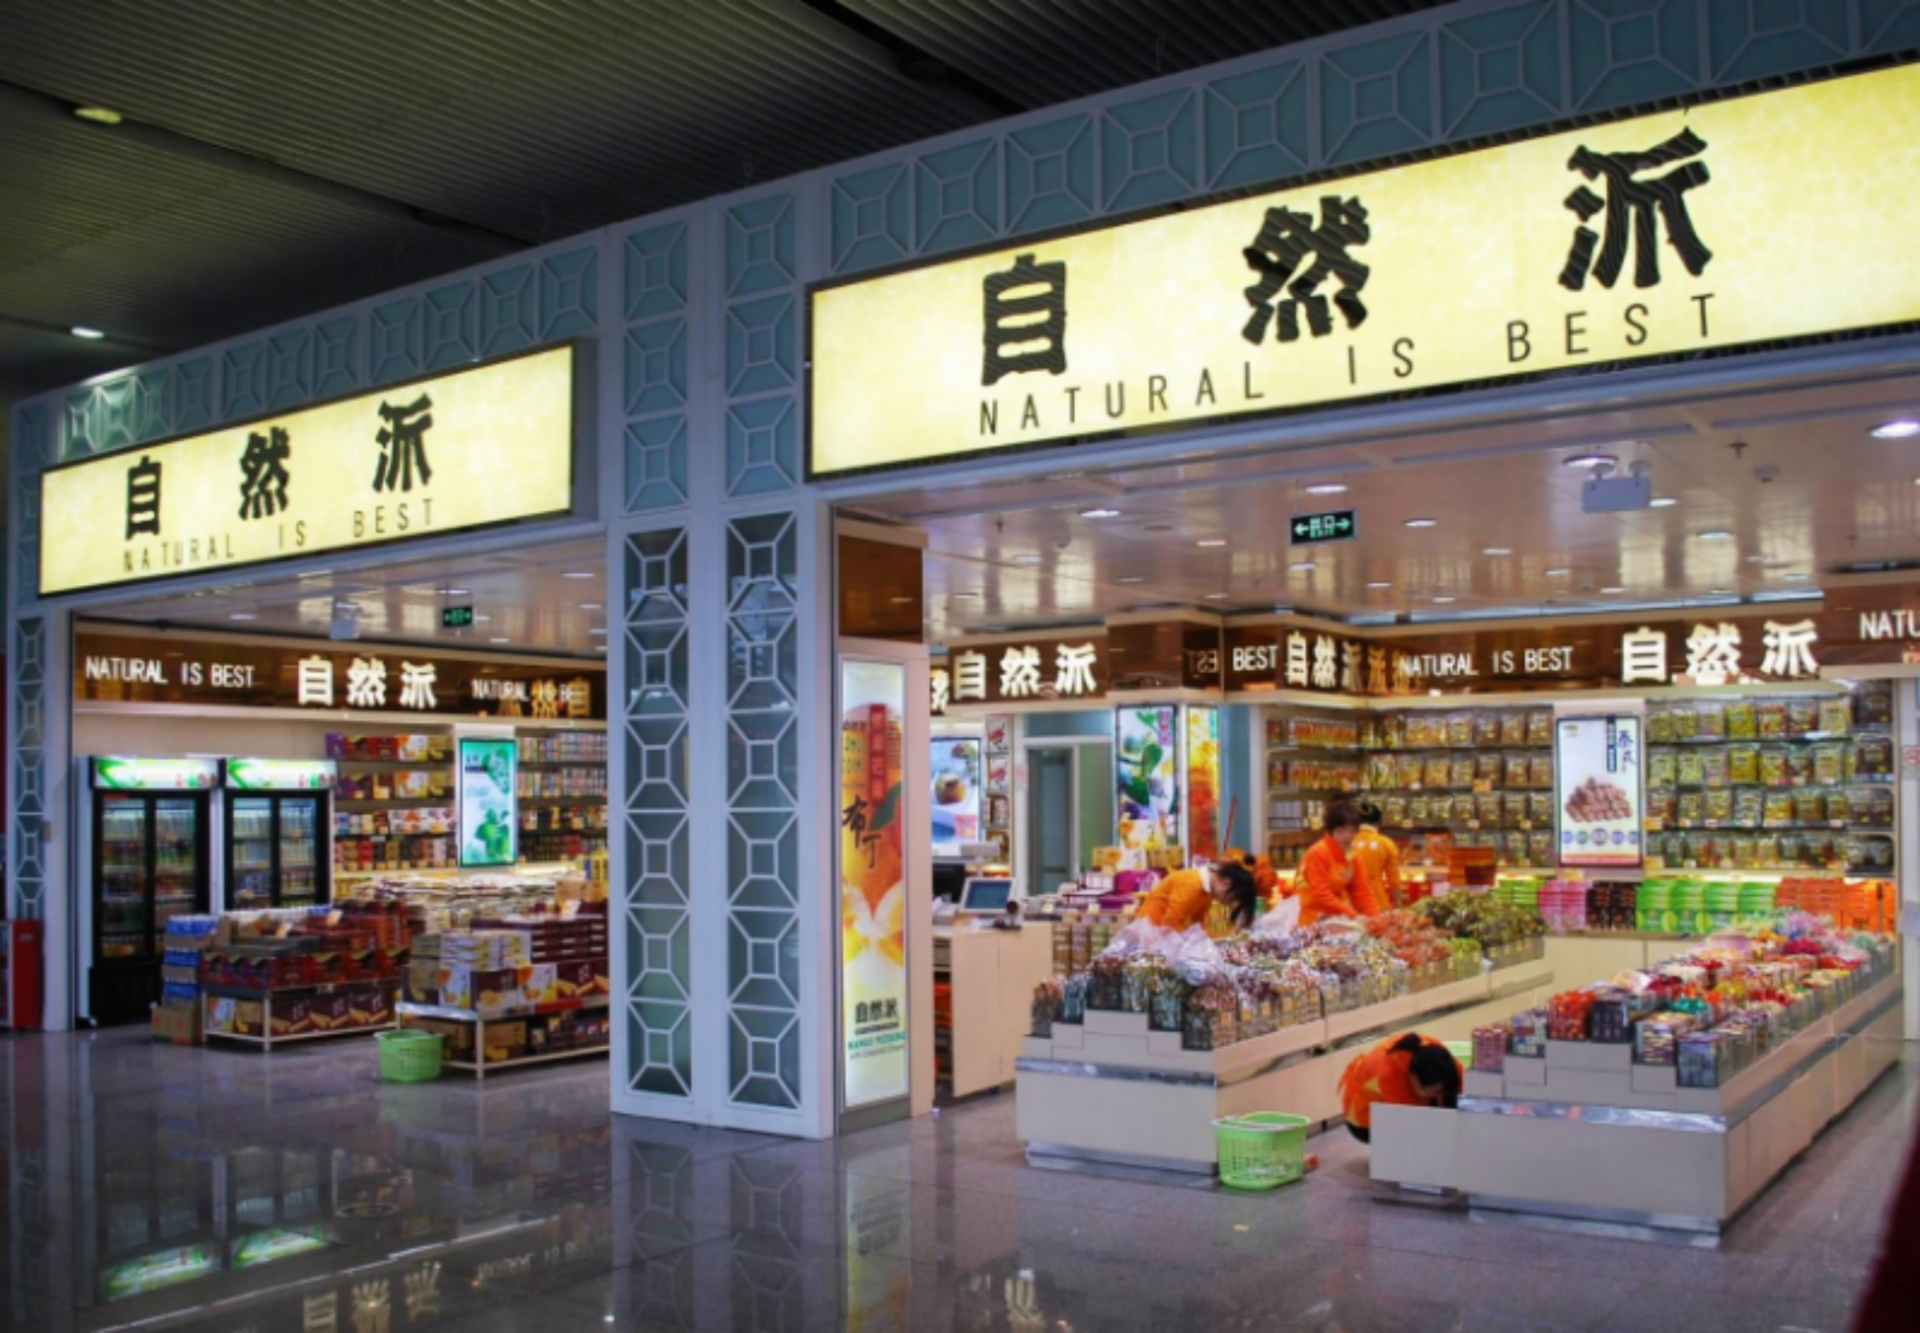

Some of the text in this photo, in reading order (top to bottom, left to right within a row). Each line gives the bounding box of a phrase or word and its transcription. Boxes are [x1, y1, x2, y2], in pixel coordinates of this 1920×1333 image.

[981, 126, 1713, 387] 自然派
[979, 292, 1716, 437] NATURAL IS BEST
[124, 393, 433, 541] 自然派
[122, 498, 434, 573] NATURAL IS BEST
[85, 655, 256, 689] NATURAL IS BEST
[297, 654, 438, 710] 自然派
[953, 642, 1098, 700] 自然派
[1232, 645, 1278, 672] BEST
[1401, 652, 1480, 678] NATURAL
[1493, 651, 1514, 674] IS
[1524, 646, 1574, 673] BEST
[1621, 619, 1818, 684] 自然派
